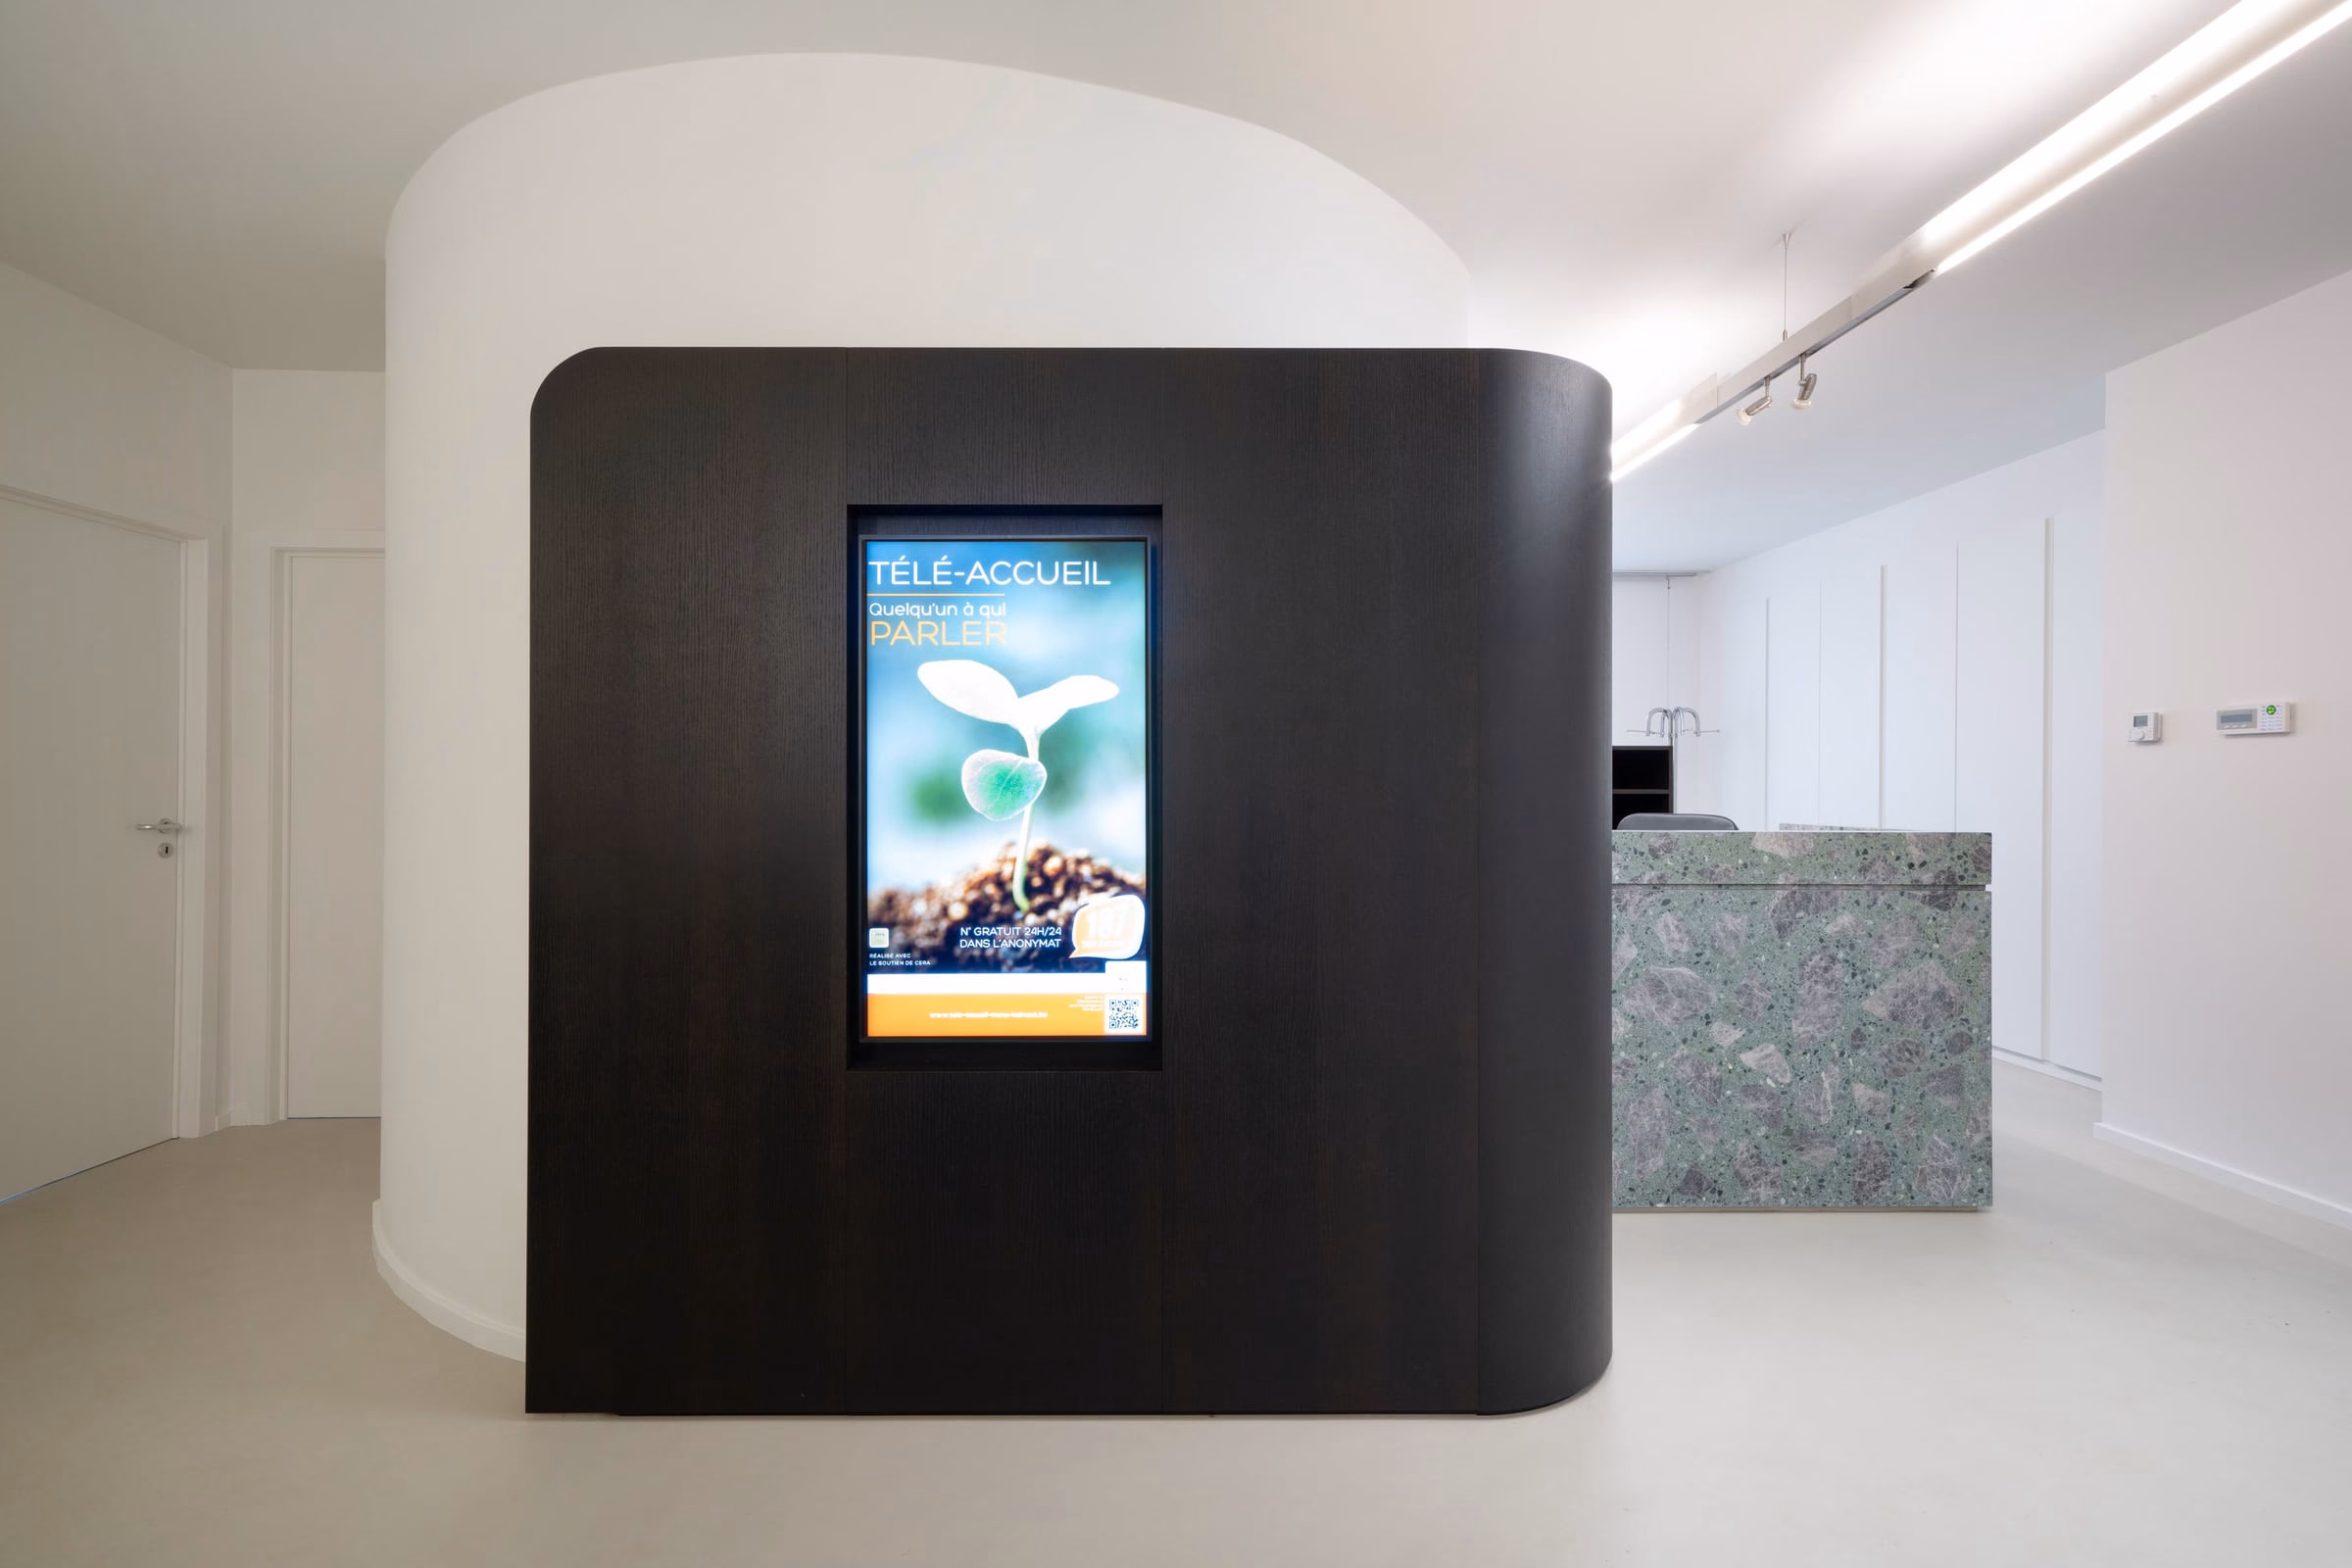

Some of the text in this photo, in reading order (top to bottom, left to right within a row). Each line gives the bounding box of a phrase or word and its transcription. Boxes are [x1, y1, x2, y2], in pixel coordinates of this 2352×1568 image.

[868, 555, 1111, 585] TÉLÉ-ACCUEIL
[868, 602, 1006, 618] Quelqu'un à qui
[871, 620, 1007, 646] PARLER
[973, 927, 1021, 936] GRATUIT
[1024, 927, 1062, 937] 24H/24
[960, 939, 1061, 949] DANS L'ANONYMAT
